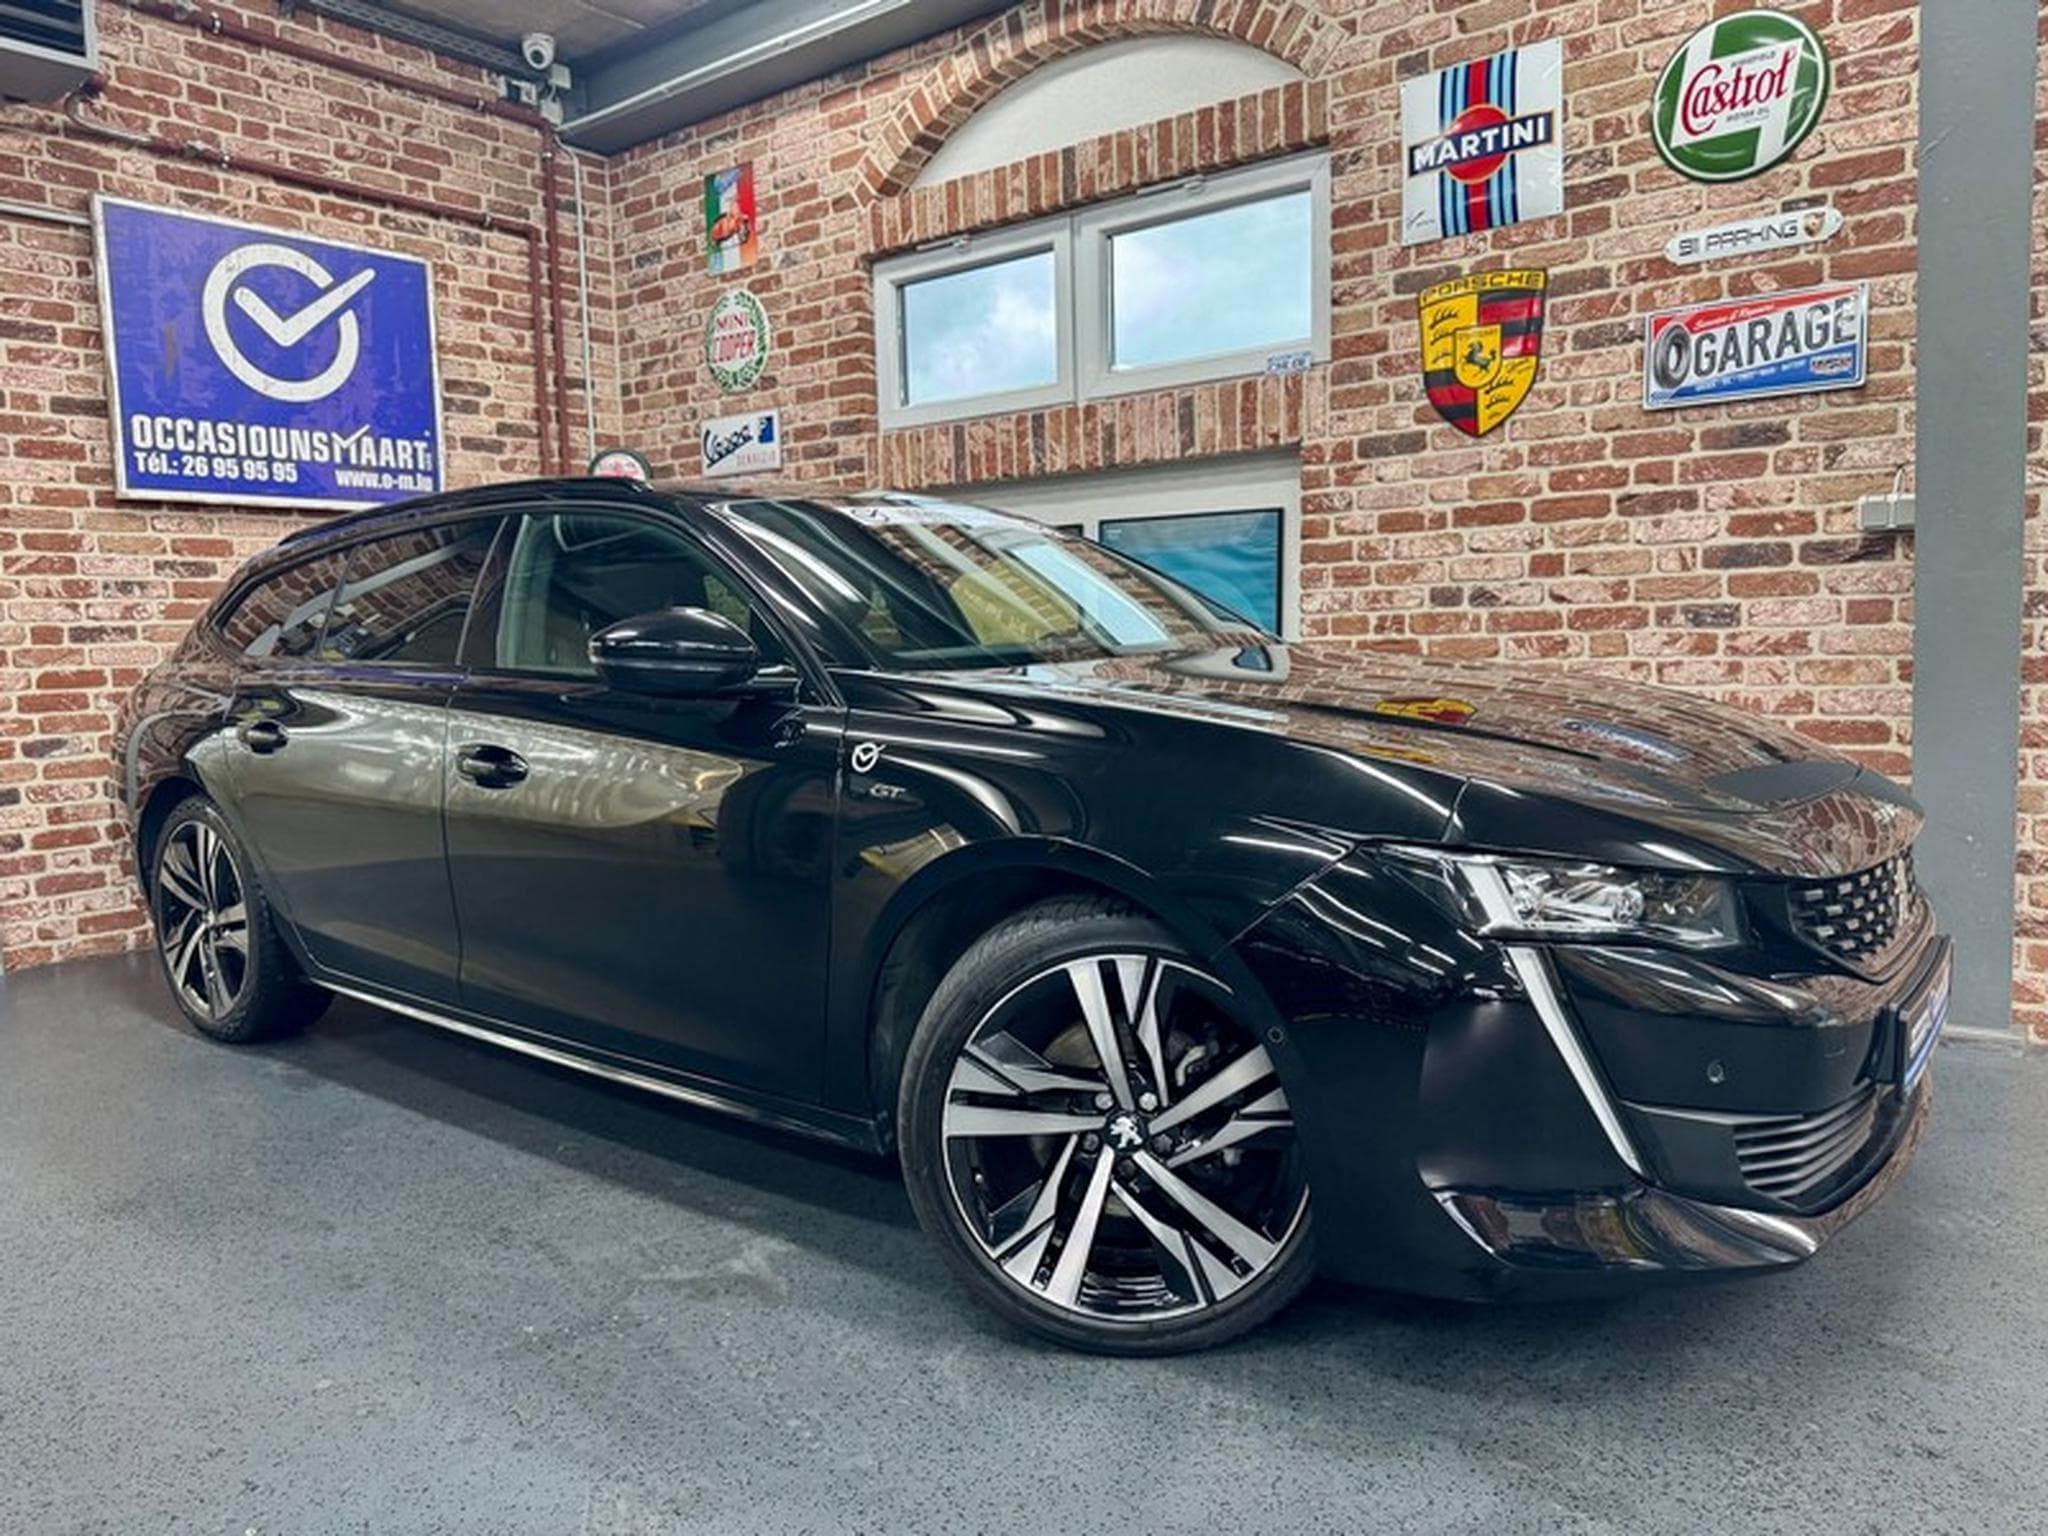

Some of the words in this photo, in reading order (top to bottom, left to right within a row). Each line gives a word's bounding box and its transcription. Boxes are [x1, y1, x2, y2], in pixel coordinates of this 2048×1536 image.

[1681, 46, 1798, 136] Castrol
[1413, 117, 1546, 172] MARTINI
[1706, 220, 1798, 251] PARKING
[1422, 271, 1542, 303] PORSCHE
[715, 311, 752, 333] MINI
[1693, 299, 1858, 378] GARAGE
[712, 328, 757, 364] COOPER
[131, 413, 429, 472] OCCASIOUNSMAART
[181, 454, 209, 477] 26
[212, 456, 239, 479] 95
[242, 459, 269, 482] 95
[272, 461, 298, 484] 95
[869, 783, 907, 799] GT
